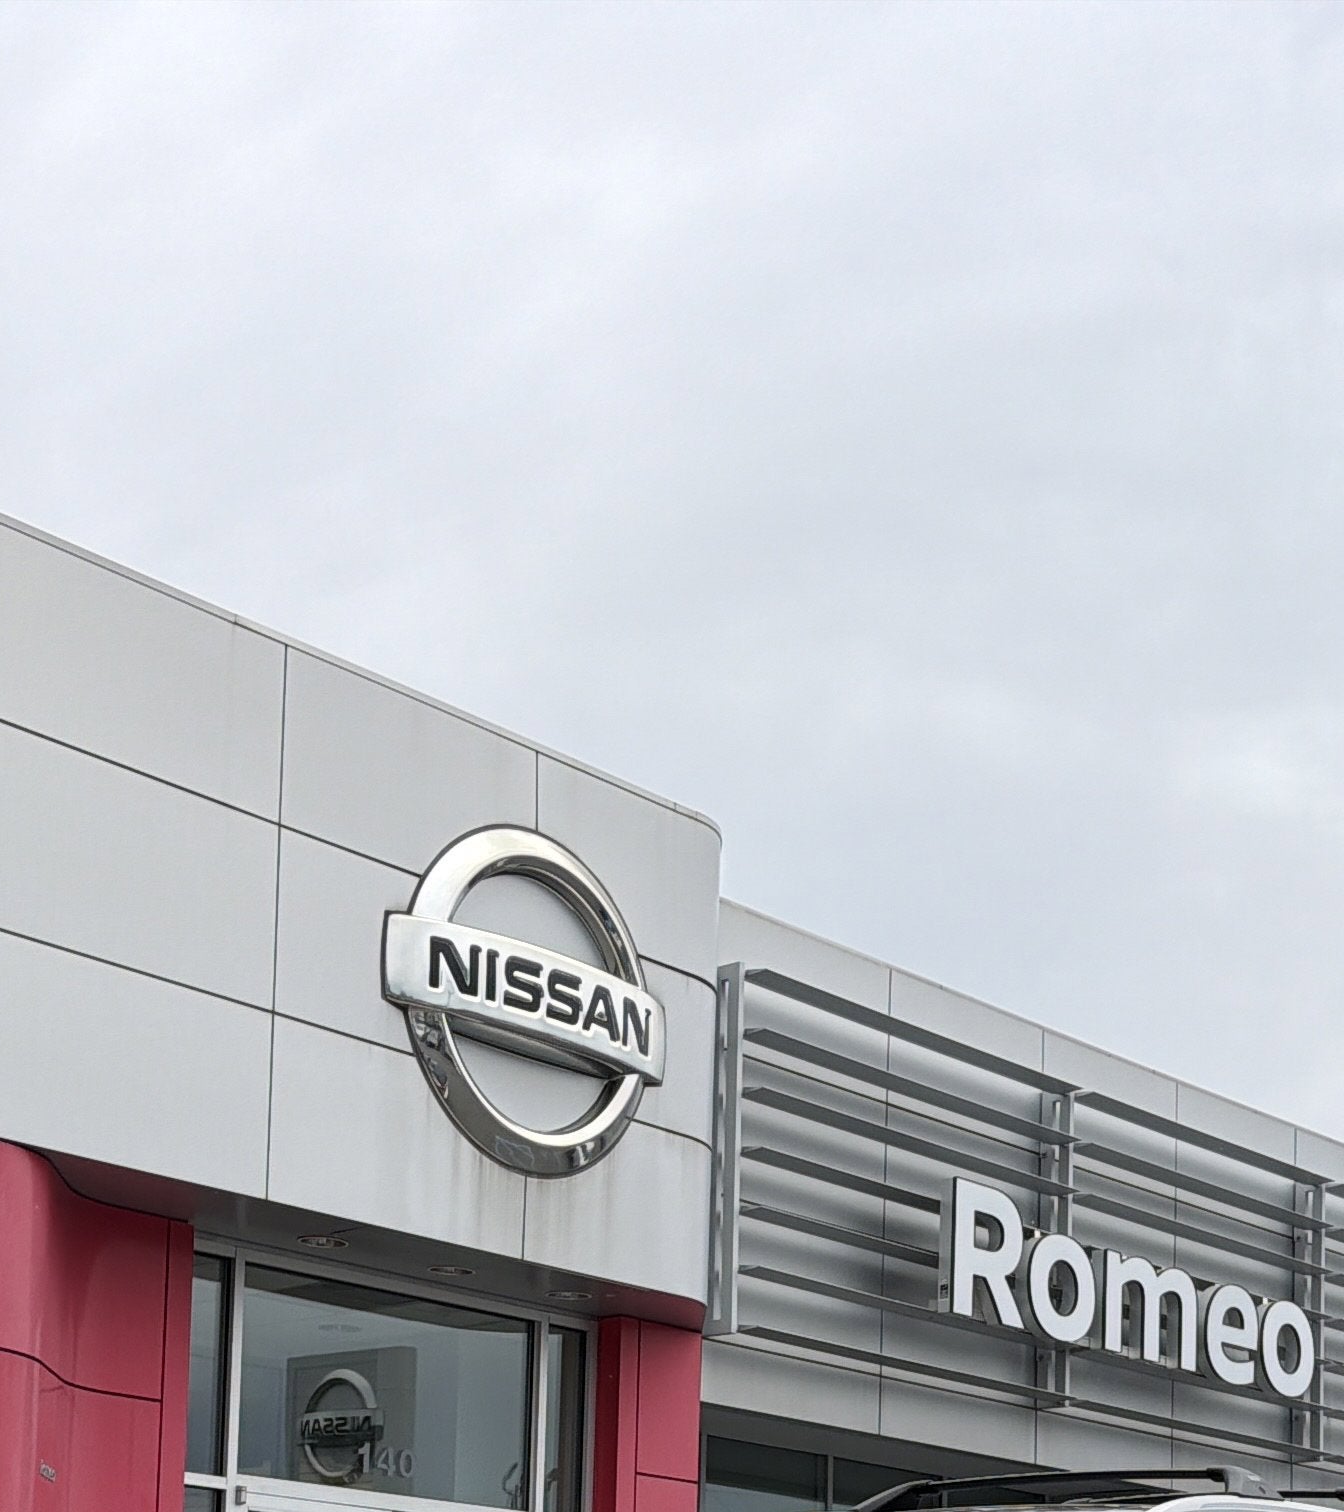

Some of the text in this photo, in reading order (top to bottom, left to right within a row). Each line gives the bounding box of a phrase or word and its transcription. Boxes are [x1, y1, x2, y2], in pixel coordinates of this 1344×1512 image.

[427, 935, 652, 1058] NISSAN
[952, 1176, 1316, 1398] Romeo
[357, 1441, 414, 1478] 140
